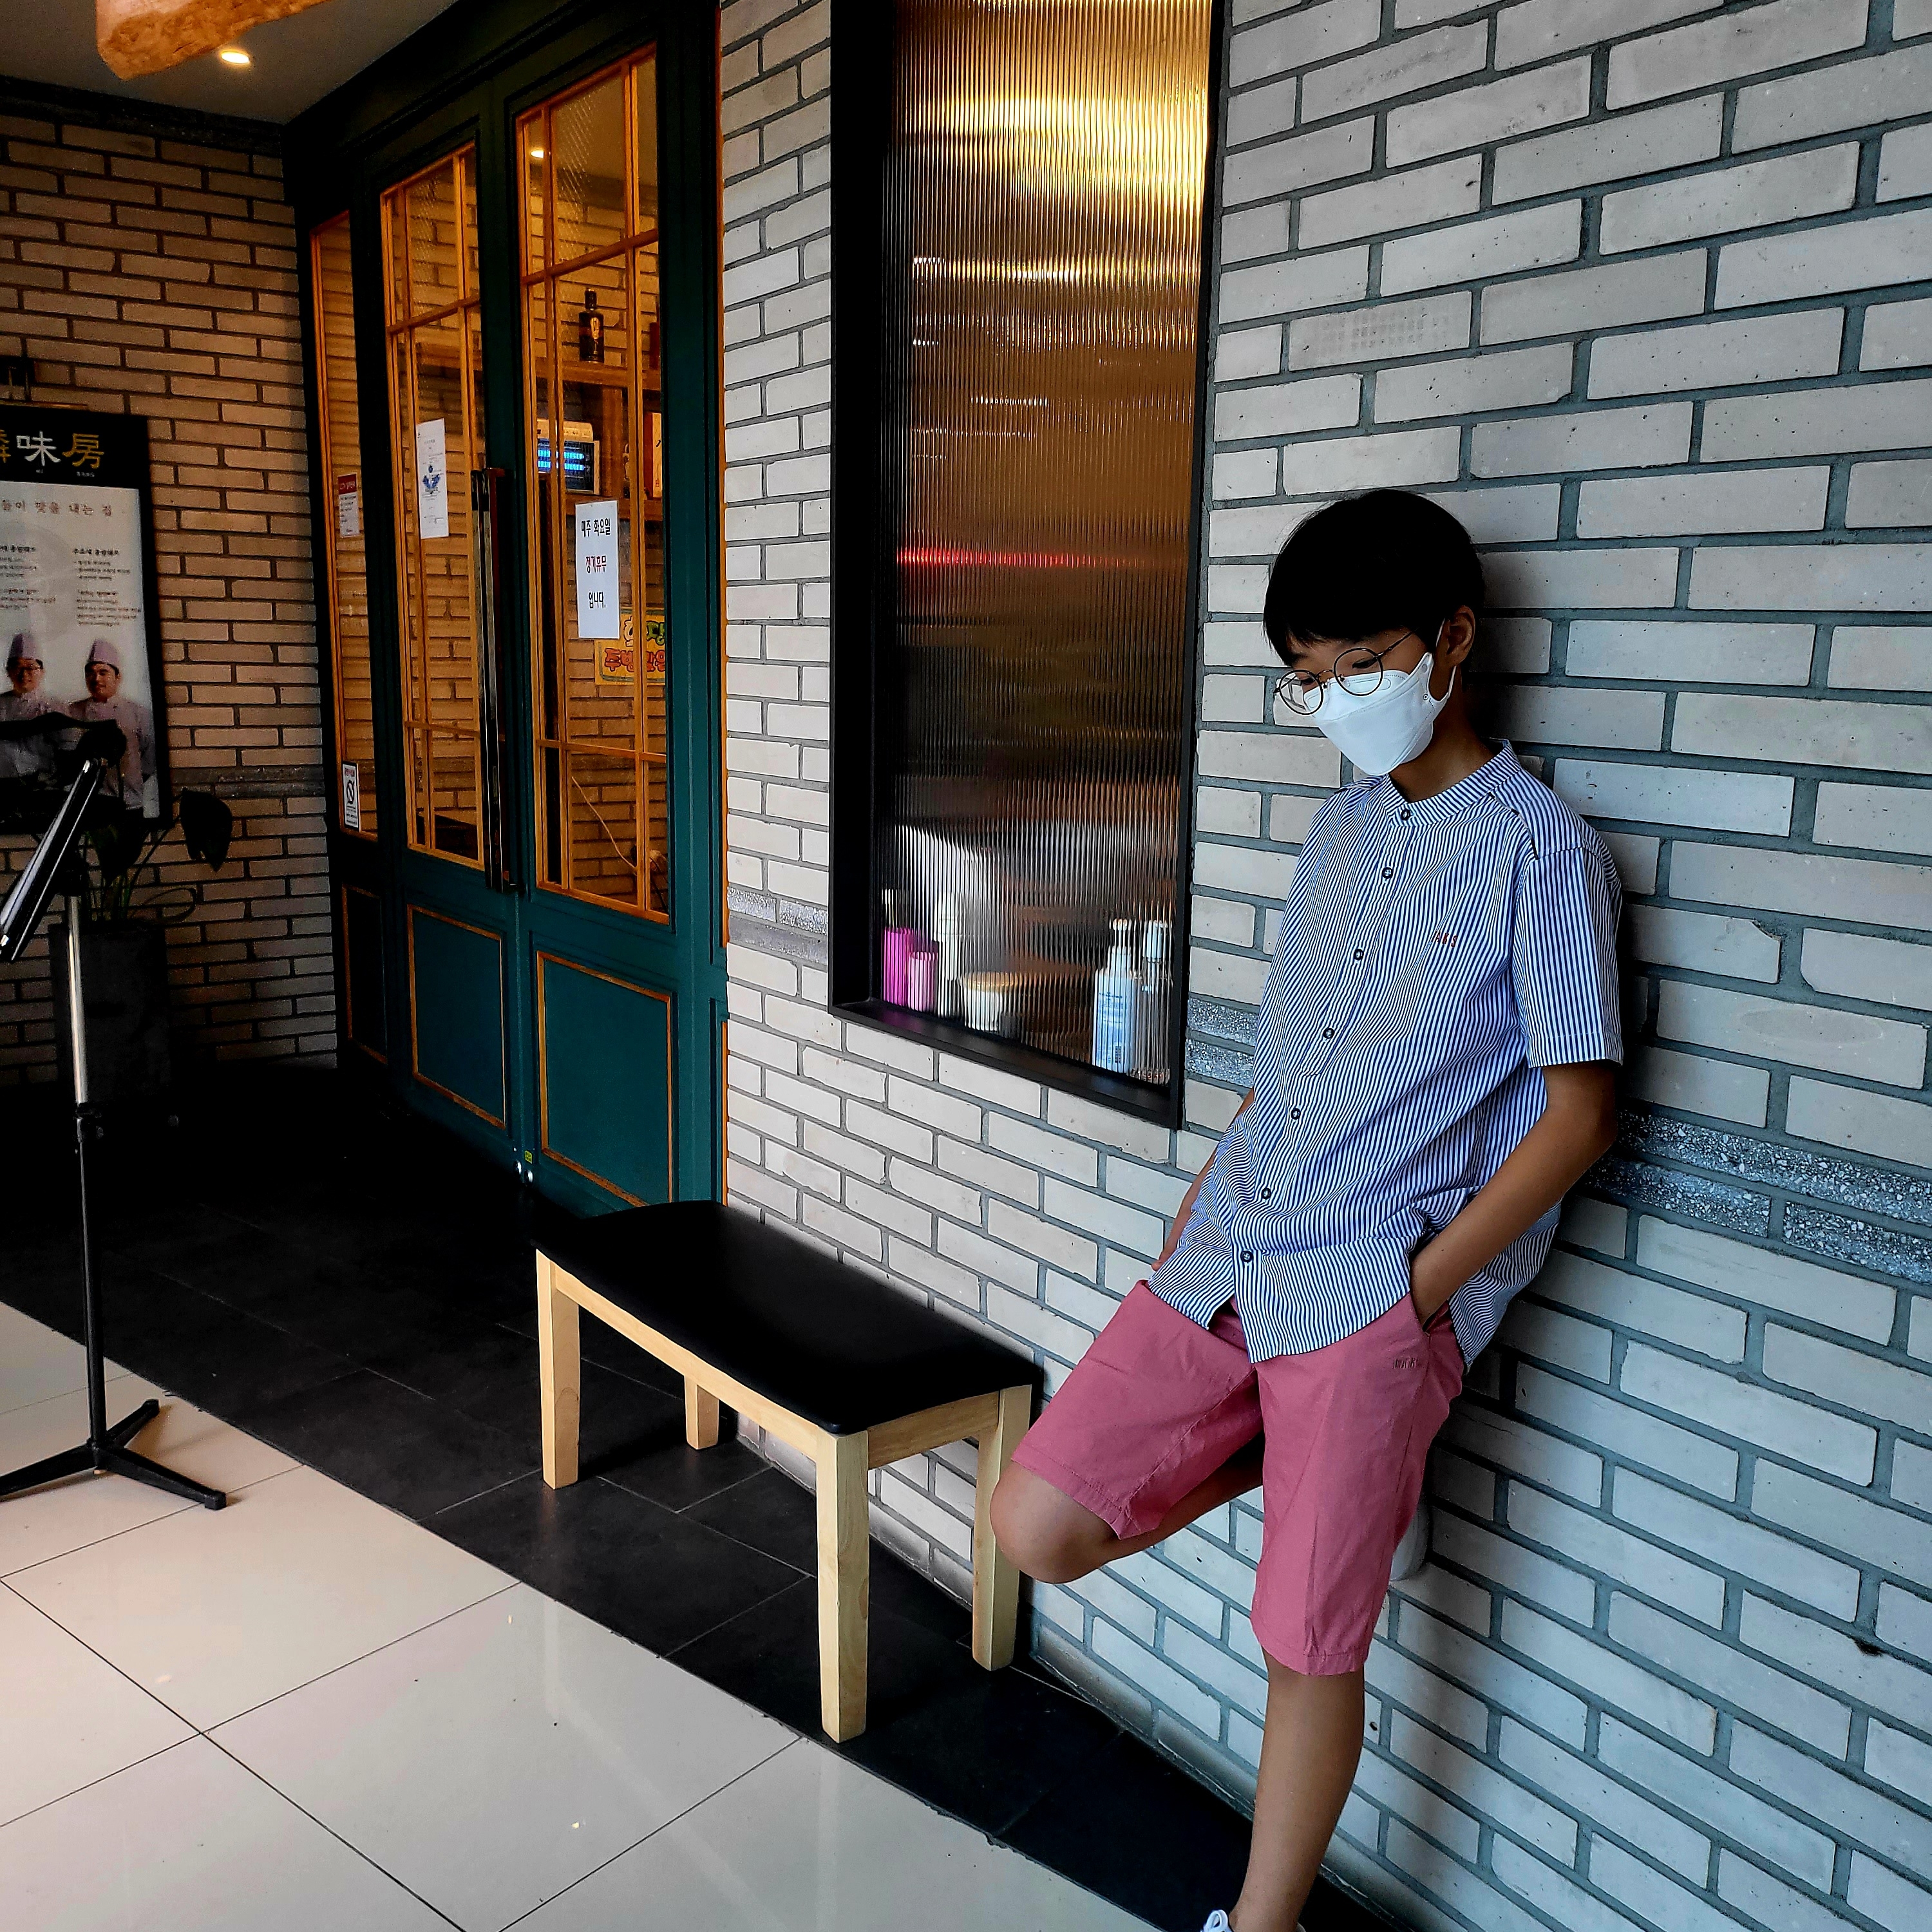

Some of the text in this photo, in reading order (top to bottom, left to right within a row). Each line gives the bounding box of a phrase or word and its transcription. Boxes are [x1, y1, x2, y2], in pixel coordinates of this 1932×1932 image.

[581, 518, 611, 537] 매주 화요일
[585, 555, 607, 574] 정기휴무
[588, 591, 606, 609] 입니다.
